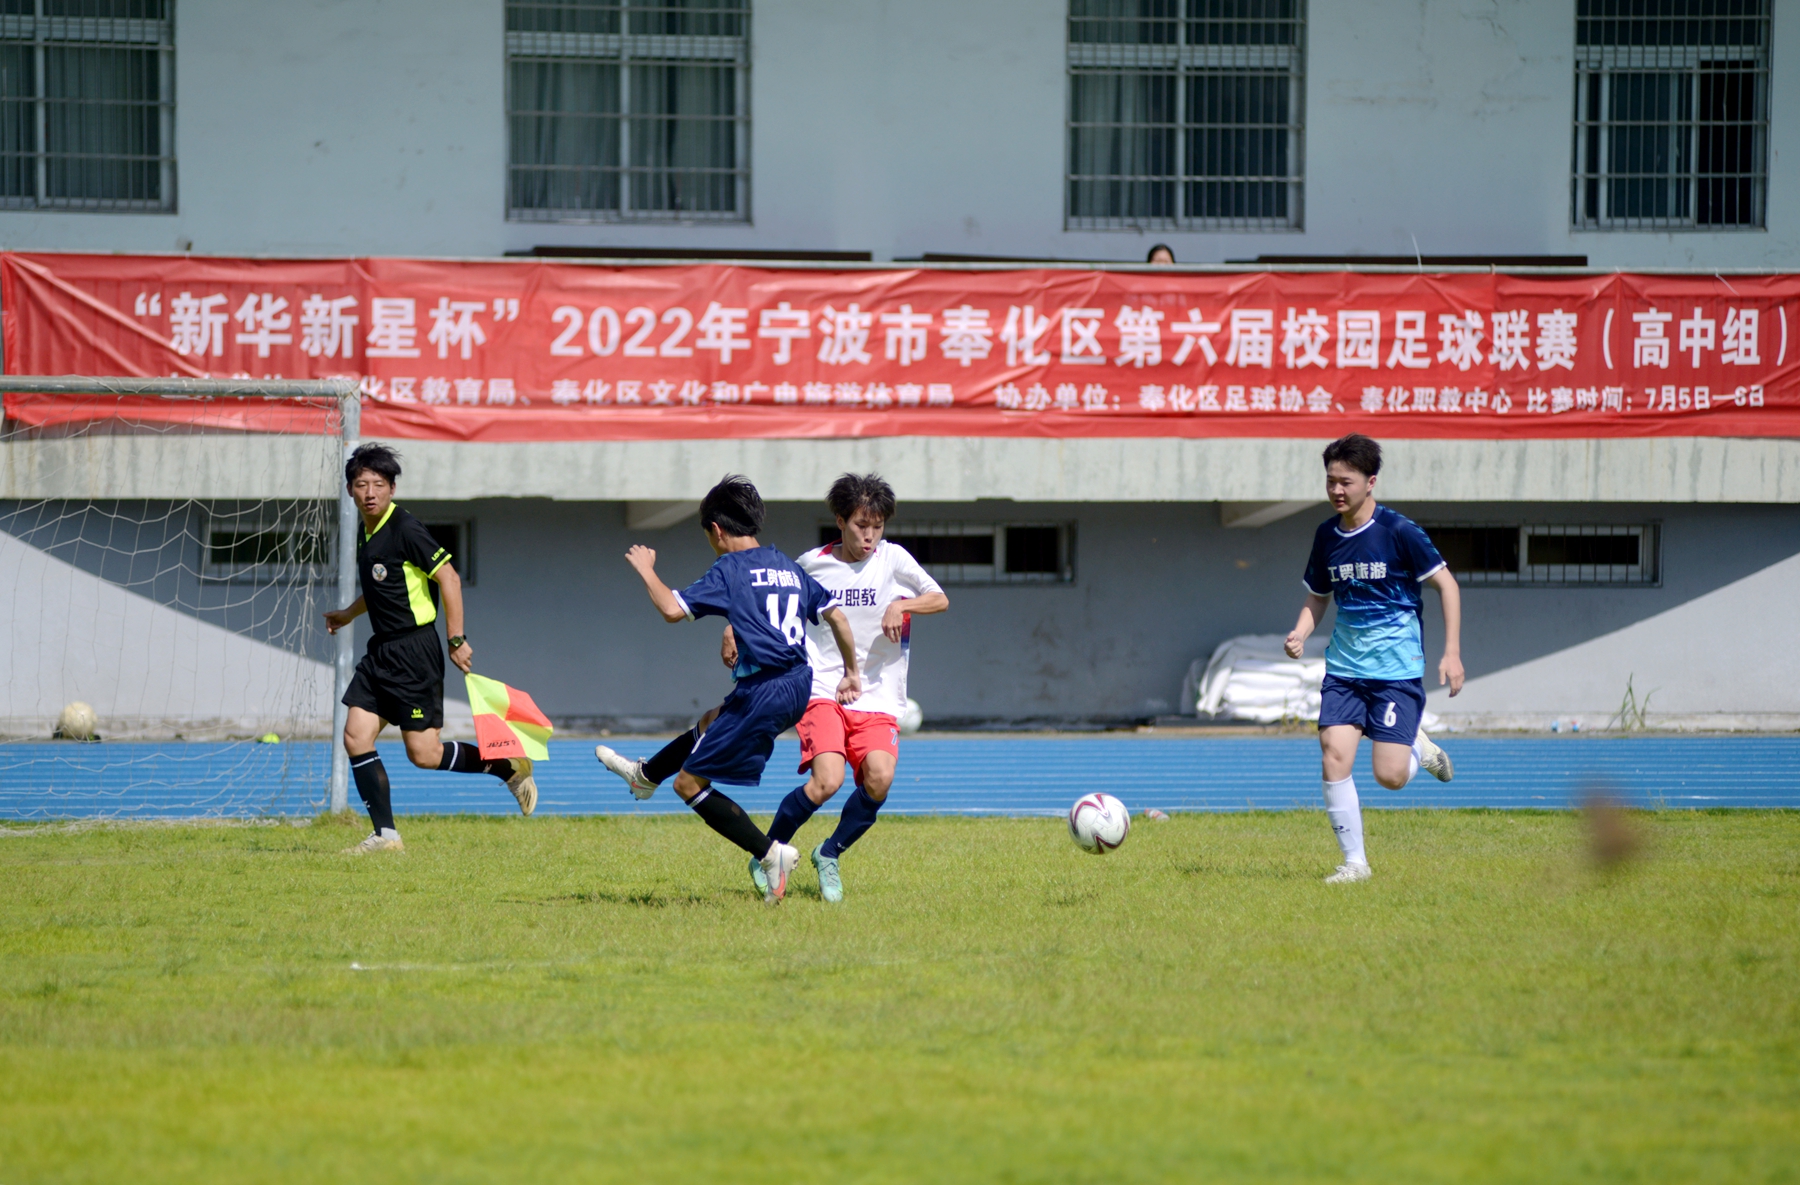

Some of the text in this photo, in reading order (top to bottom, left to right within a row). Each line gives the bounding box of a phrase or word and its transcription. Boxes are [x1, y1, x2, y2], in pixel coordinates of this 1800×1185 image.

[1328, 562, 1387, 582] 工贸旅游
[766, 593, 805, 646] 16
[1384, 702, 1397, 727] 6
